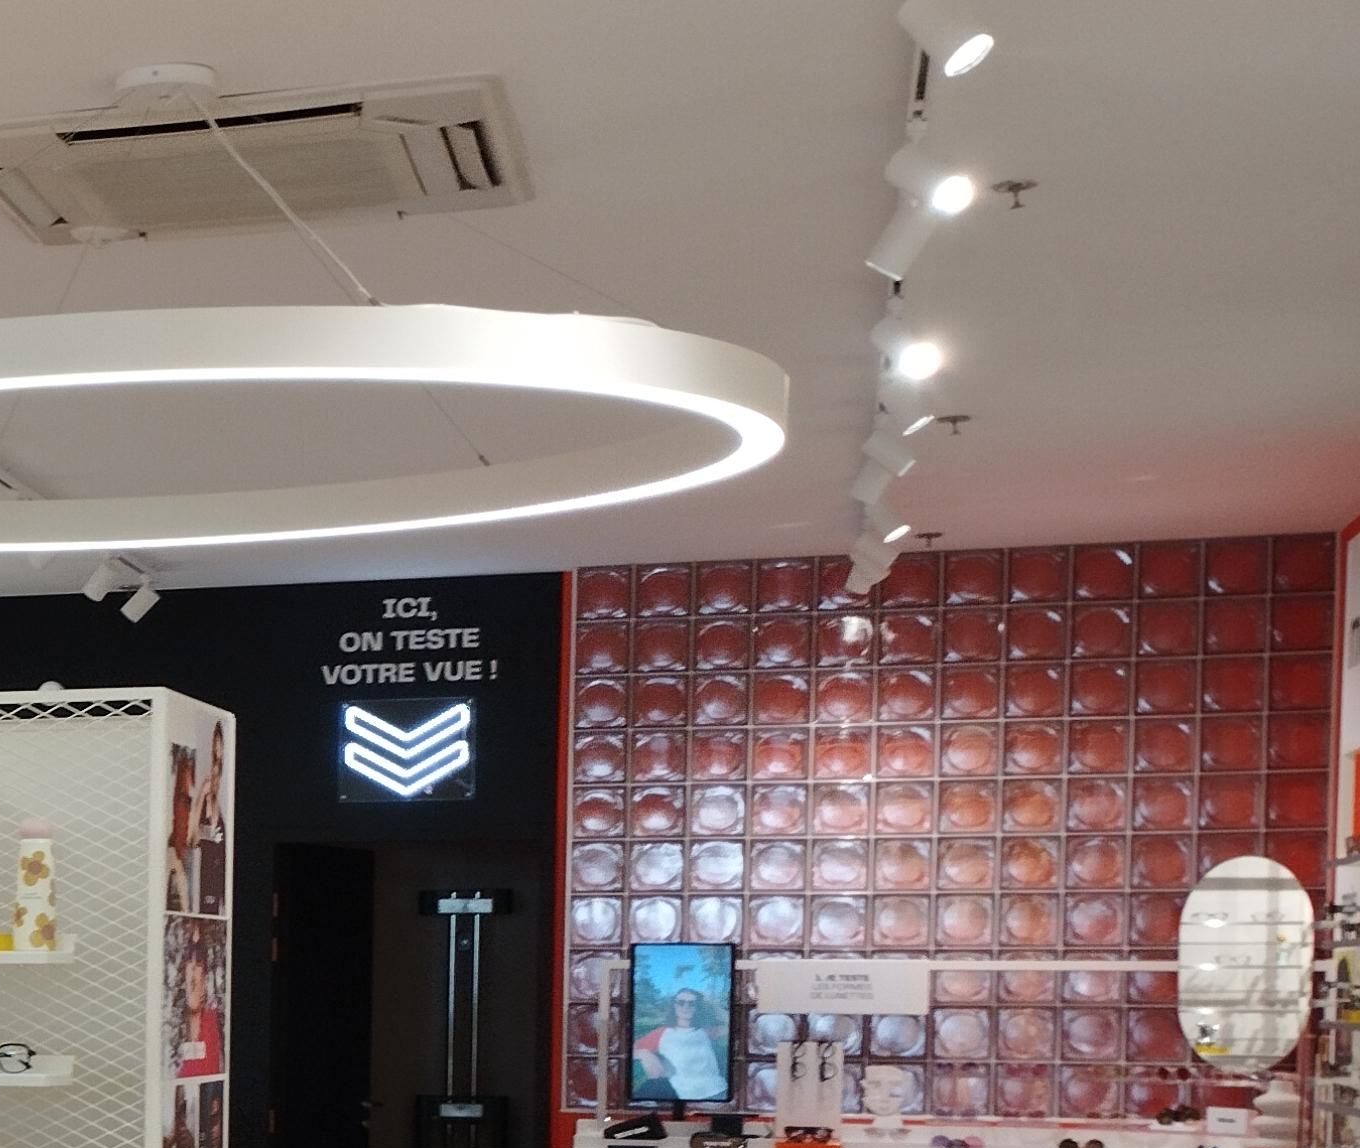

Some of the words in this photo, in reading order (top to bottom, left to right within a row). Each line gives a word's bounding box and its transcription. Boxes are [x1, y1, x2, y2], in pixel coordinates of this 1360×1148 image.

[382, 596, 438, 622] ICI,
[338, 631, 384, 653] ON
[390, 627, 480, 651] TESTE
[320, 661, 416, 685] VOTRE
[422, 660, 483, 682] VUE
